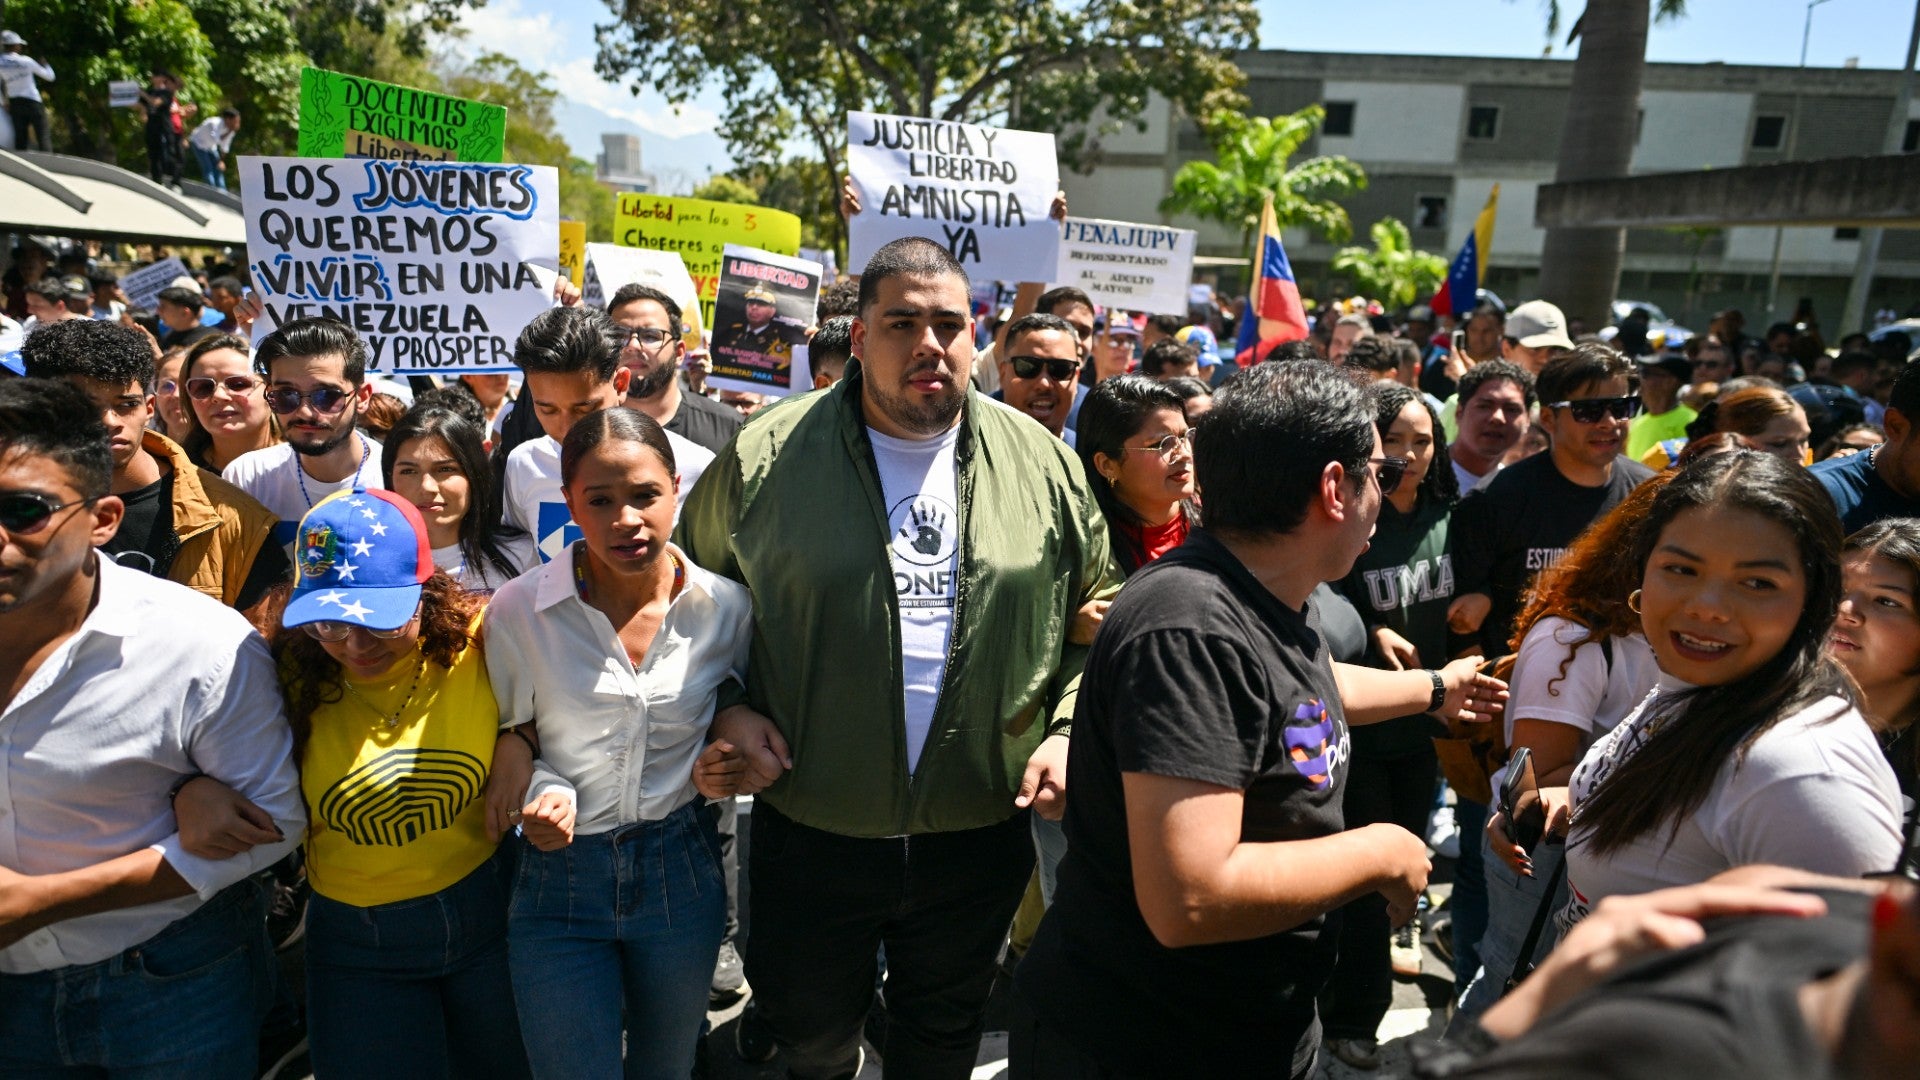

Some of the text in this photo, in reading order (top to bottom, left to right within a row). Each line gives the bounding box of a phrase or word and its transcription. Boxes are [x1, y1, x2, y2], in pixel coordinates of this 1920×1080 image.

[340, 77, 467, 128] DOCENTES
[349, 107, 460, 151] EXIGIMOS
[863, 119, 998, 158] JUSTICIA Y
[909, 152, 1018, 185] LIBERTAD
[262, 160, 532, 213] LOS JÓVENES
[621, 198, 757, 232] Libertad para los 3
[880, 184, 1026, 228] AMNISTIA
[258, 208, 497, 257] QUEREMOS
[624, 228, 703, 254] Choferes
[942, 224, 981, 263] YA
[1064, 222, 1179, 250] FENAJUPV
[729, 259, 810, 291] LIBERTAD
[1070, 250, 1168, 266] REPRESENTANDO
[398, 262, 445, 296] EN
[460, 261, 543, 295] UNA
[1081, 270, 1154, 284] AL ADULTO
[1092, 283, 1133, 294] MAYOR
[264, 303, 489, 334] VENEZUELA
[369, 335, 386, 370] Y
[1363, 554, 1455, 611] UMA
